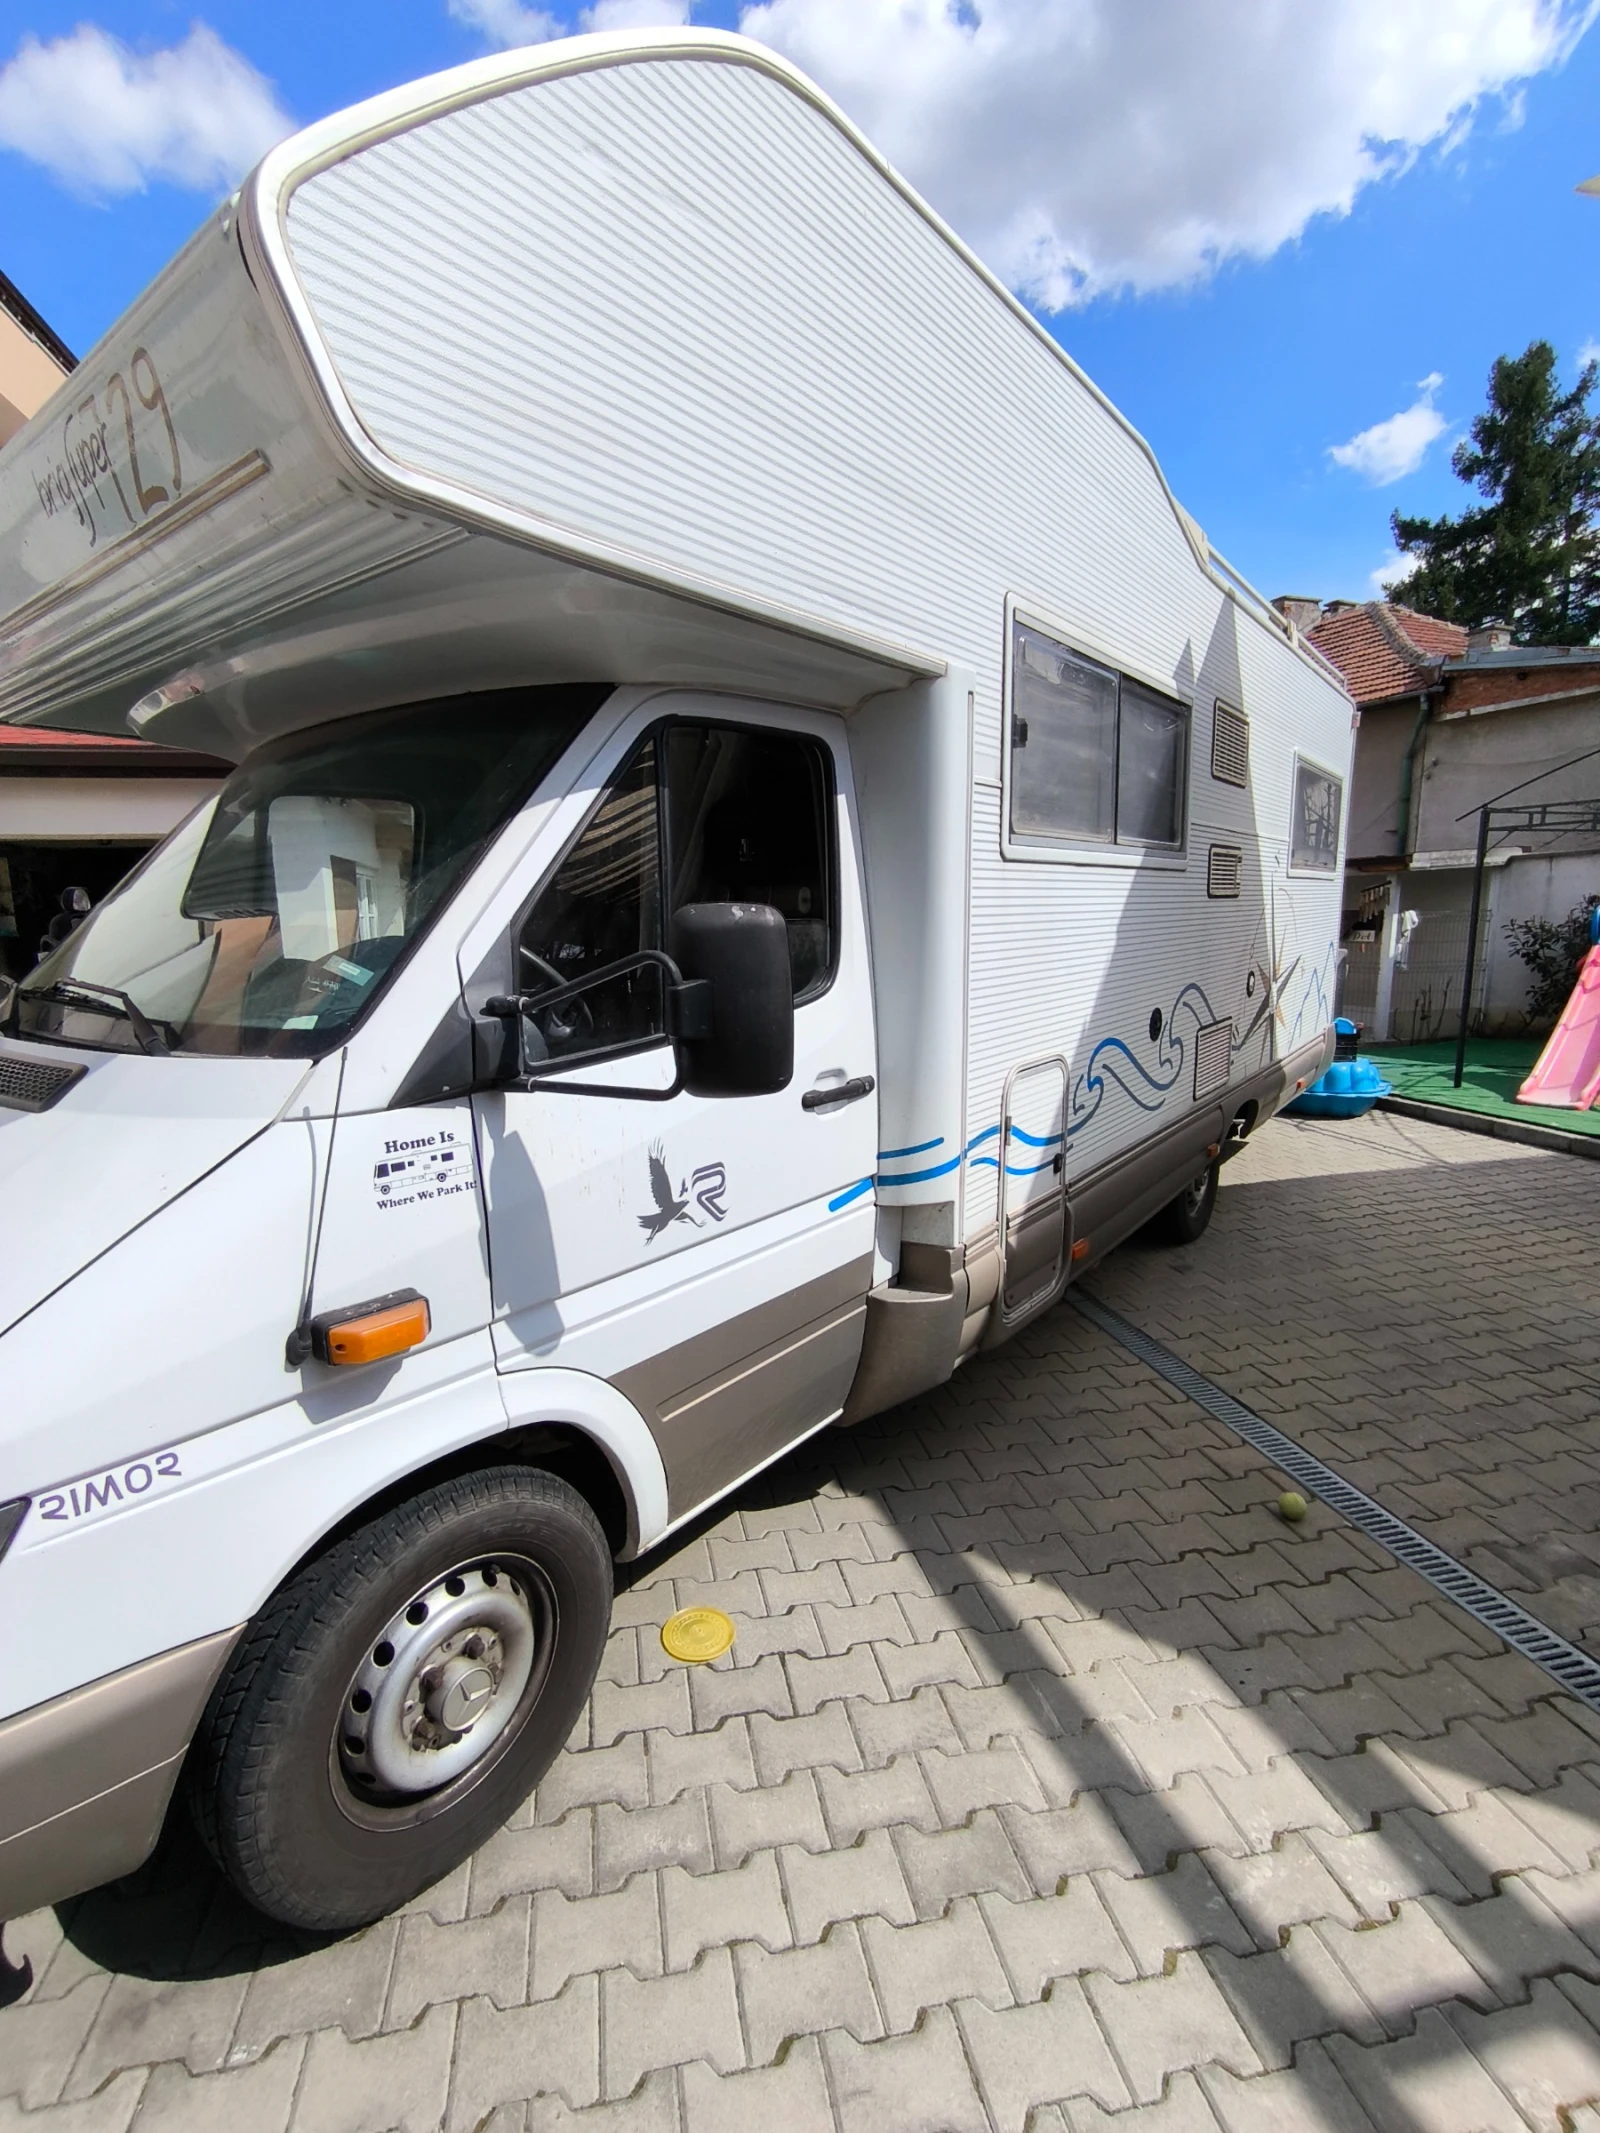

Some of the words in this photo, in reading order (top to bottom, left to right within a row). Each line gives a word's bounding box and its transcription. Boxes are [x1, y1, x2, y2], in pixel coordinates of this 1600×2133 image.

[384, 1135, 436, 1154] Home
[439, 1131, 455, 1144] Is
[376, 1195, 415, 1210] Where
[417, 1189, 435, 1201] We
[436, 1184, 463, 1197] Park
[465, 1180, 478, 1191] It!
